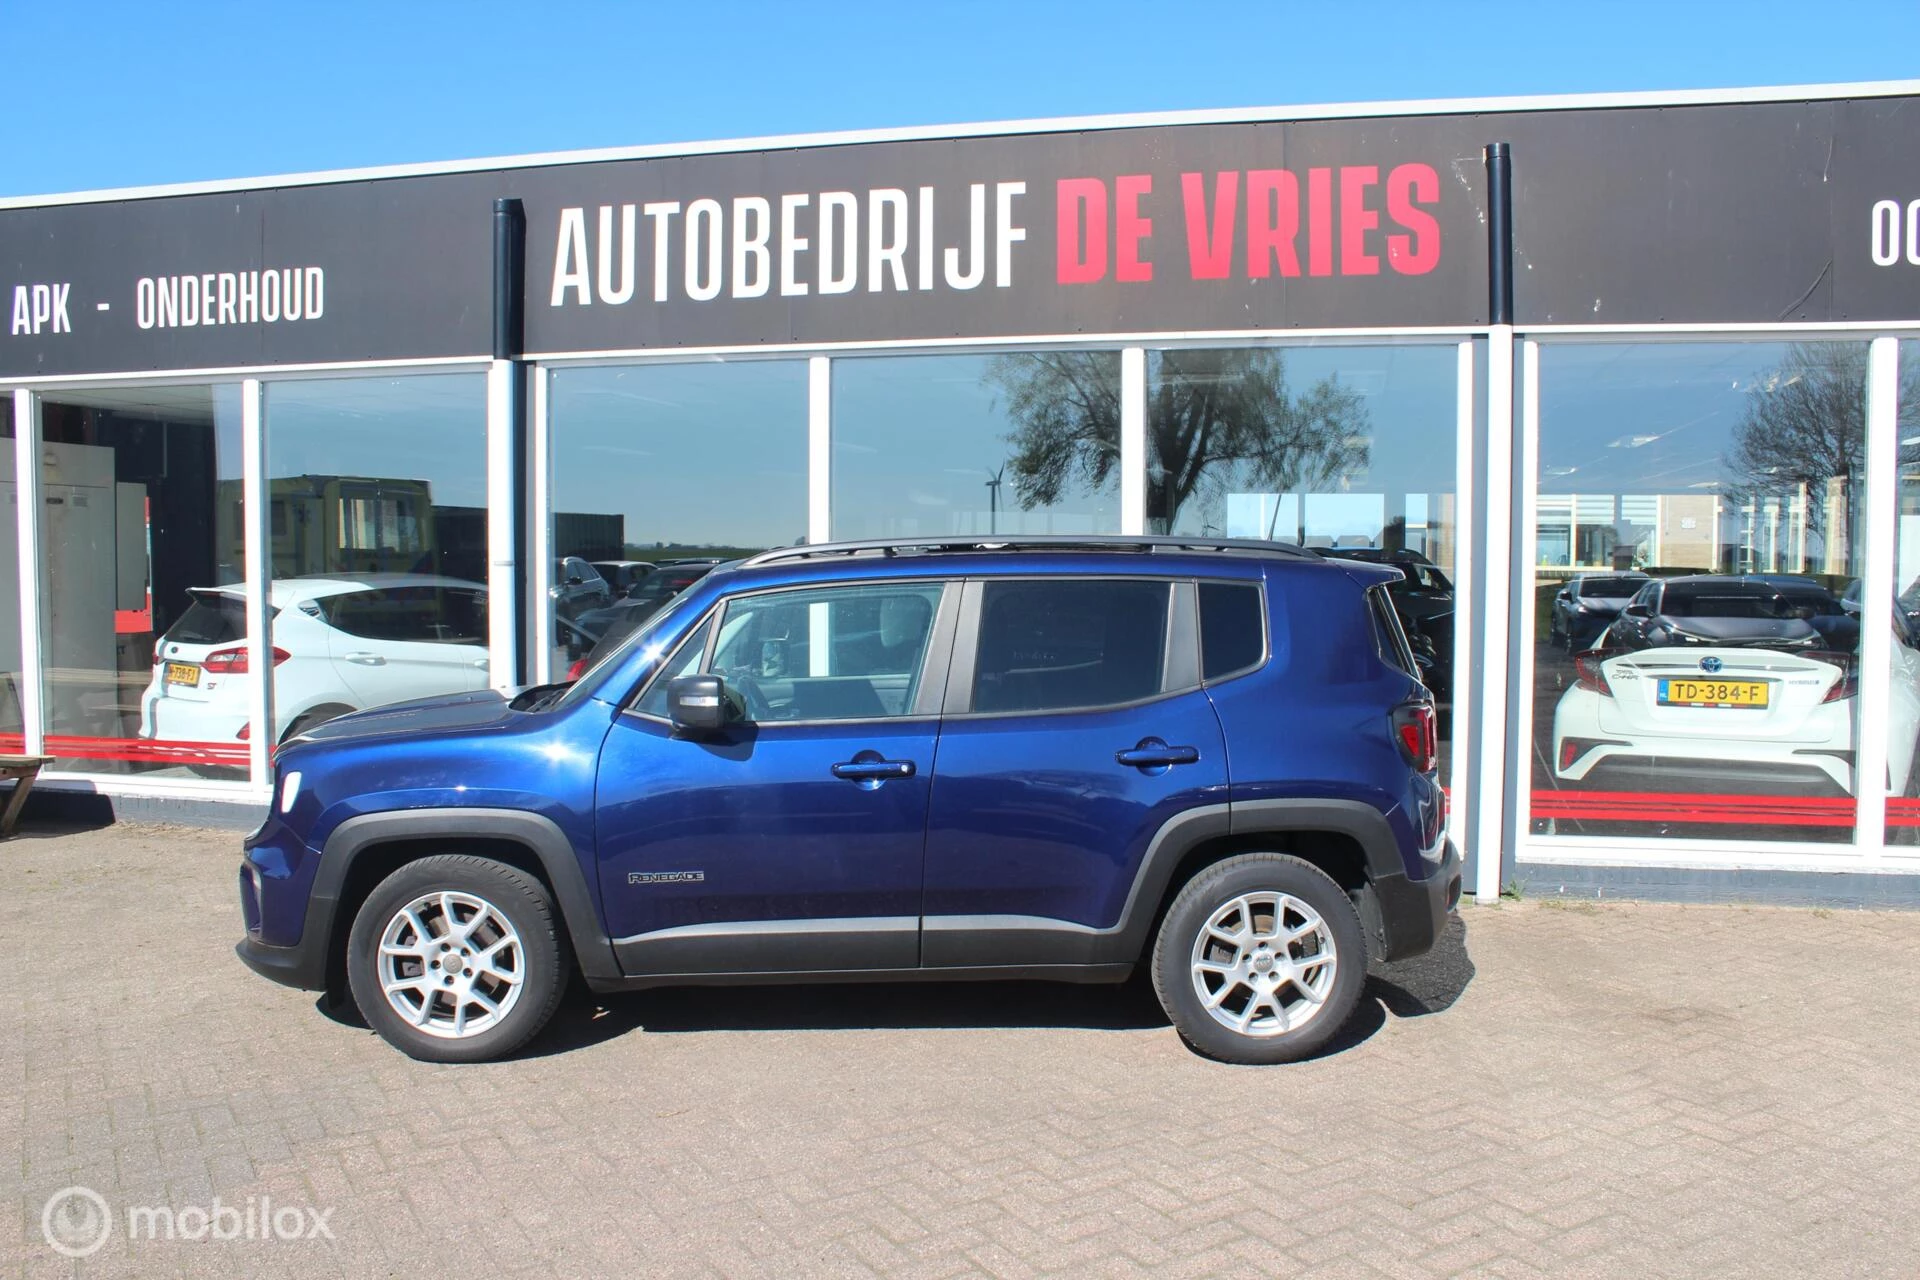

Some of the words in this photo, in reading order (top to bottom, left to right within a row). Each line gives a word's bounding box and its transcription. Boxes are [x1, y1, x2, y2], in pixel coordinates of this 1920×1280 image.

[551, 181, 1027, 307] AUTOBEDRIJF
[1056, 175, 1153, 285] DE
[1181, 163, 1440, 281] VRIES
[11, 282, 71, 336] APK
[137, 266, 324, 330] ONDERHOUD
[1675, 683, 1760, 702] TD-384-F
[628, 870, 705, 884] RENEGADE
